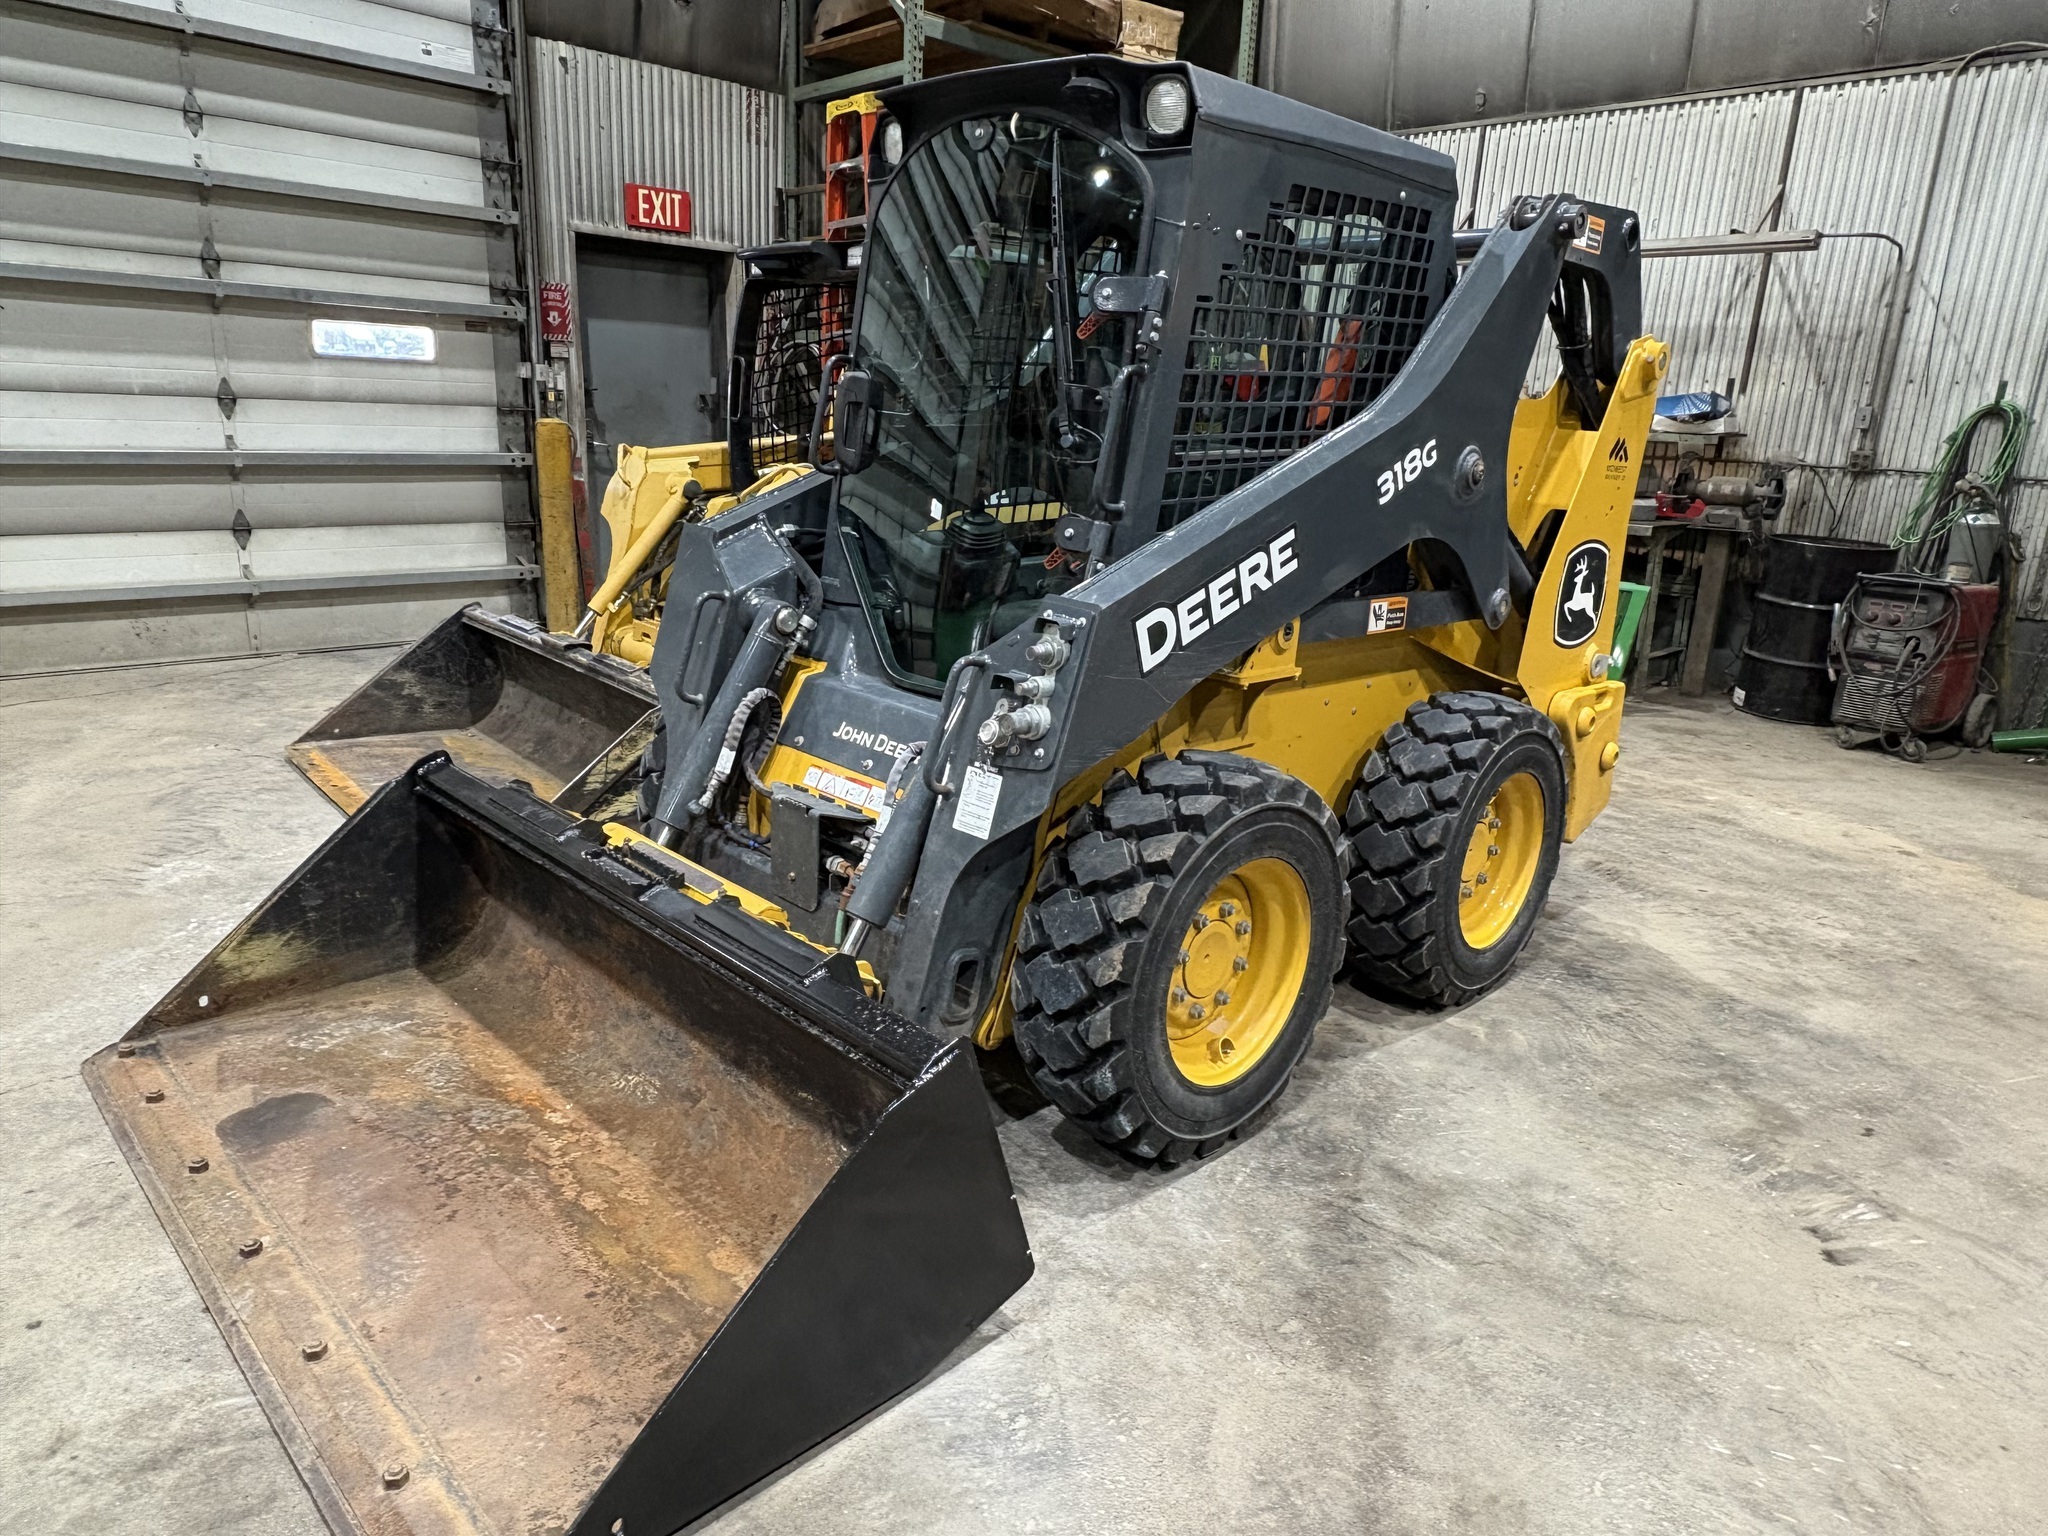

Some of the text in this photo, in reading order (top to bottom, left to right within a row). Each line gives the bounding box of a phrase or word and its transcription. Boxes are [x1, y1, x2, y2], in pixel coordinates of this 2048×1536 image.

[638, 188, 682, 228] EXIT
[543, 291, 562, 300] FIRE
[1377, 438, 1437, 506] 318G
[1135, 527, 1299, 674] DEERE
[832, 721, 921, 764] JOHN DEE
